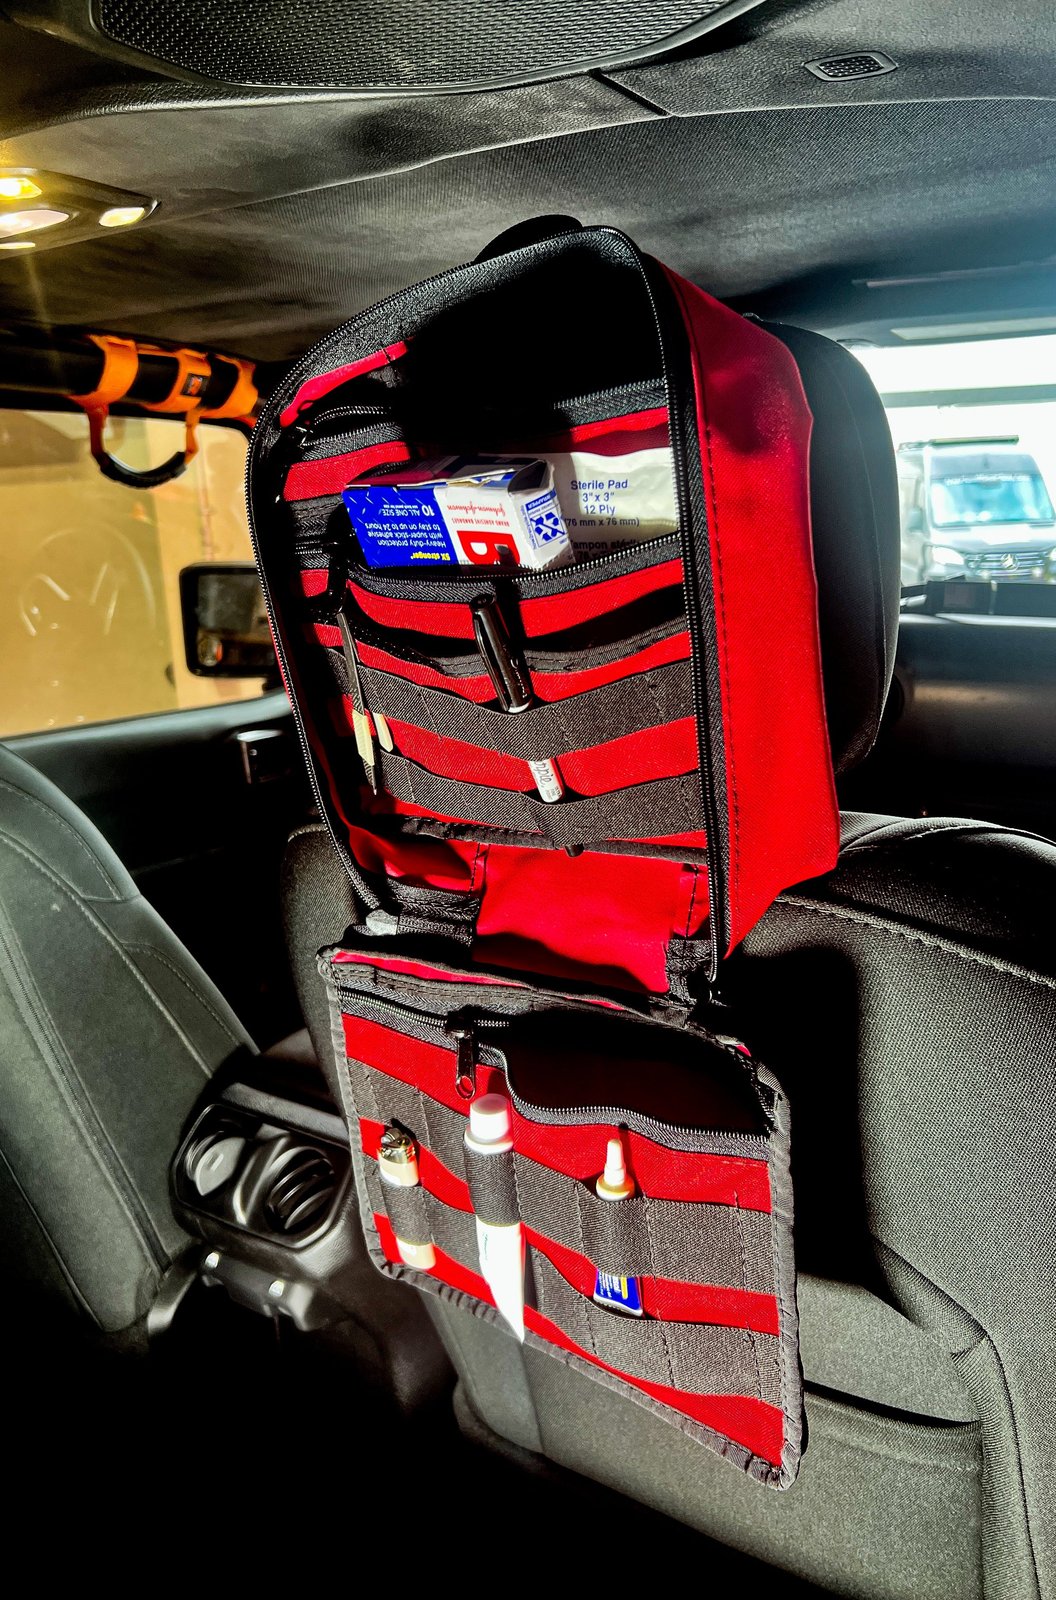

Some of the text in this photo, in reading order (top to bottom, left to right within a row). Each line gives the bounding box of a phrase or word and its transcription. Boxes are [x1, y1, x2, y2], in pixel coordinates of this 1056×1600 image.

[570, 479, 628, 490] Sterile Pad
[582, 492, 615, 502] 3" x 3"
[421, 504, 435, 517] 10
[584, 504, 615, 516] 12 Ply
[364, 522, 383, 531] hours
[418, 522, 432, 531] stay
[606, 517, 617, 526] 76
[620, 517, 640, 527] mm)
[382, 523, 391, 531] 24
[391, 523, 399, 531] to
[399, 523, 408, 531] up
[367, 530, 394, 538] adhesive
[395, 531, 428, 539] super-stick
[377, 539, 447, 548] Heavy-duty protection
[570, 539, 608, 551] ampon
